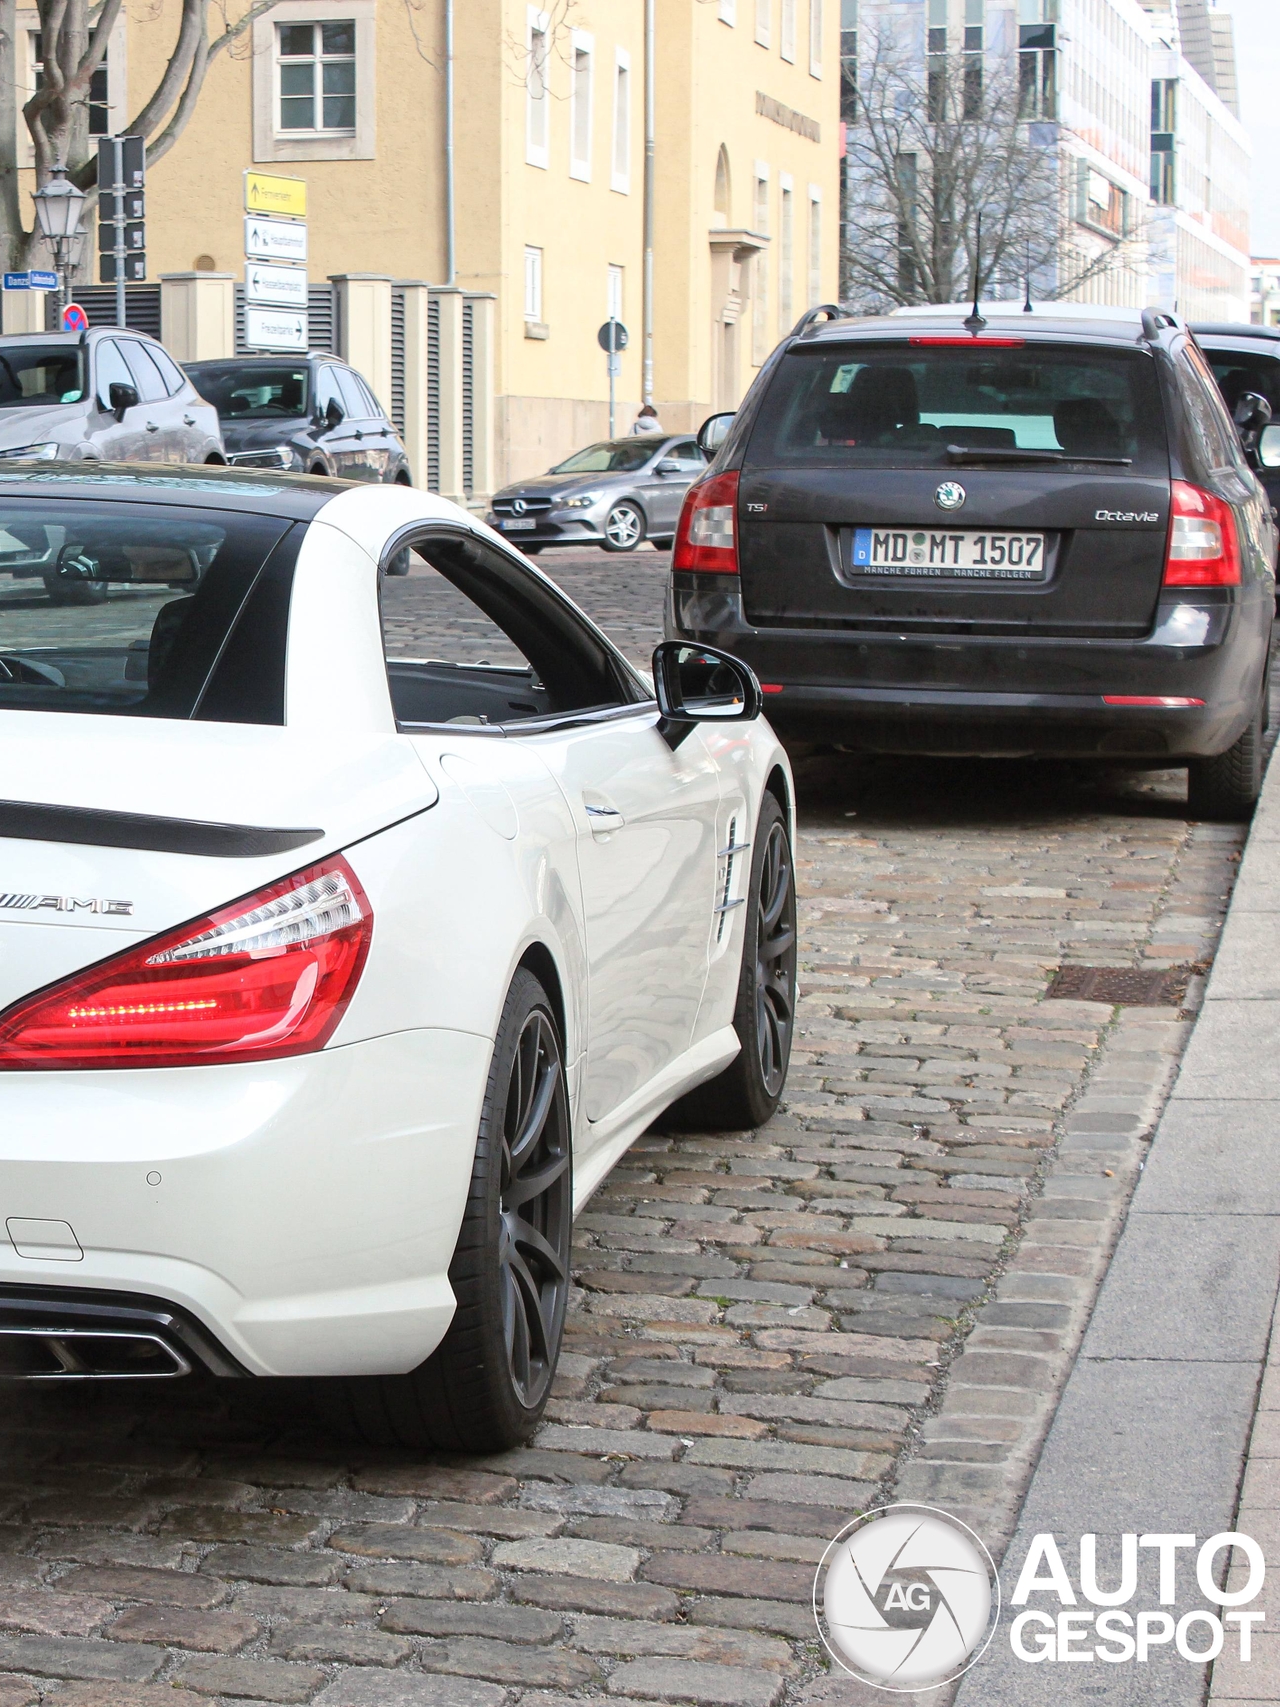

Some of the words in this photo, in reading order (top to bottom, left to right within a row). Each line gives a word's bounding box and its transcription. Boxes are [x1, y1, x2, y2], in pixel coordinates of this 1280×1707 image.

[1095, 510, 1159, 522] Octavia
[858, 550, 866, 560] D
[873, 533, 908, 562] MD
[929, 535, 965, 564] MT
[972, 536, 1042, 566] 1507
[864, 566, 902, 575] MANCHE
[954, 568, 992, 578] MANCHE
[995, 570, 1031, 579] FOLGEN
[29, 894, 134, 915] AMG
